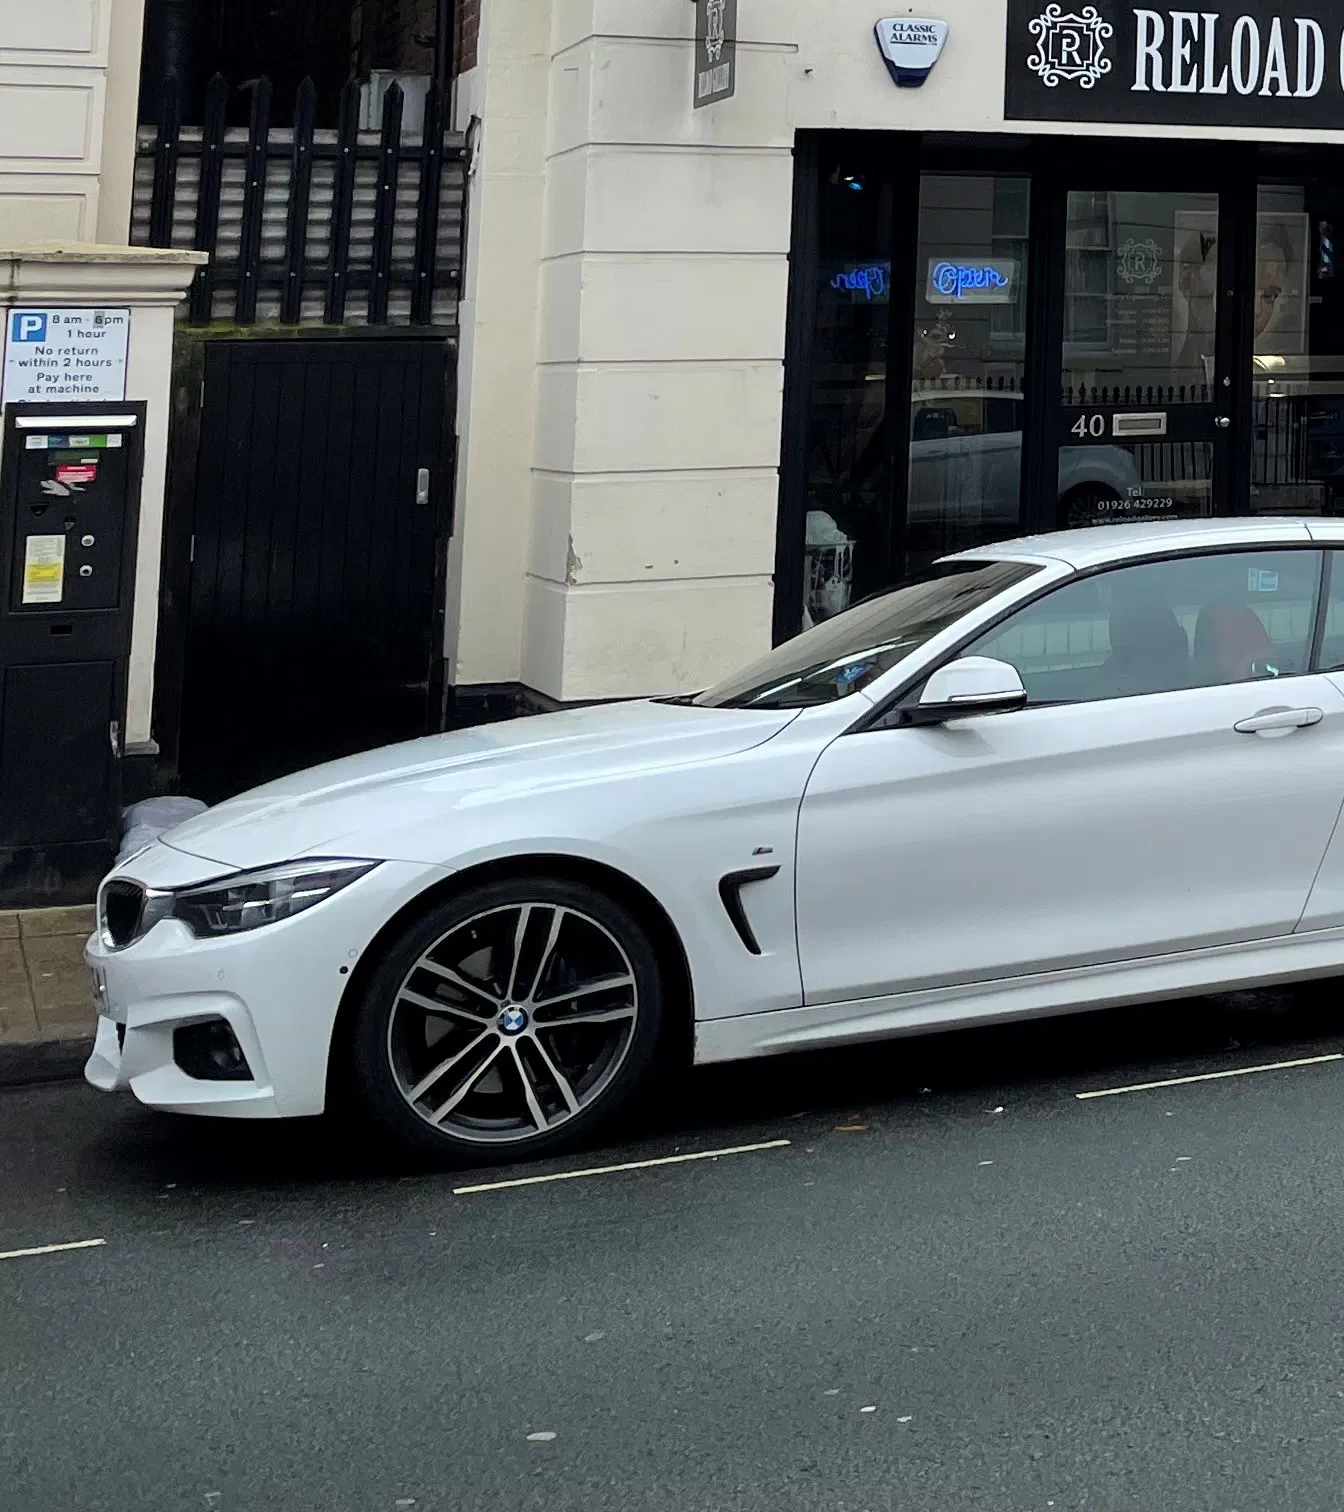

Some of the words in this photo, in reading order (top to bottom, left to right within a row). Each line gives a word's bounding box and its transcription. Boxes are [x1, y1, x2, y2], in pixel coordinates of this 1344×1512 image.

[892, 23, 937, 33] CLASSIC
[890, 33, 938, 42] ALARMS
[1130, 7, 1325, 99] RELOAD
[932, 261, 1009, 299] Open
[20, 316, 42, 340] P
[52, 315, 60, 324] 8
[67, 330, 72, 338] 1
[77, 330, 106, 338] hour
[34, 346, 53, 355] No
[58, 347, 99, 355] return
[18, 358, 58, 367] within
[63, 358, 71, 367] 2
[76, 358, 112, 367] hours
[36, 373, 60, 383] Pay
[64, 373, 93, 382] here
[28, 385, 41, 394] at
[46, 384, 100, 393] machine
[1071, 414, 1105, 437] 40
[1126, 487, 1142, 497] Tel
[1098, 500, 1131, 511] 01926
[1133, 498, 1173, 508] 429229
